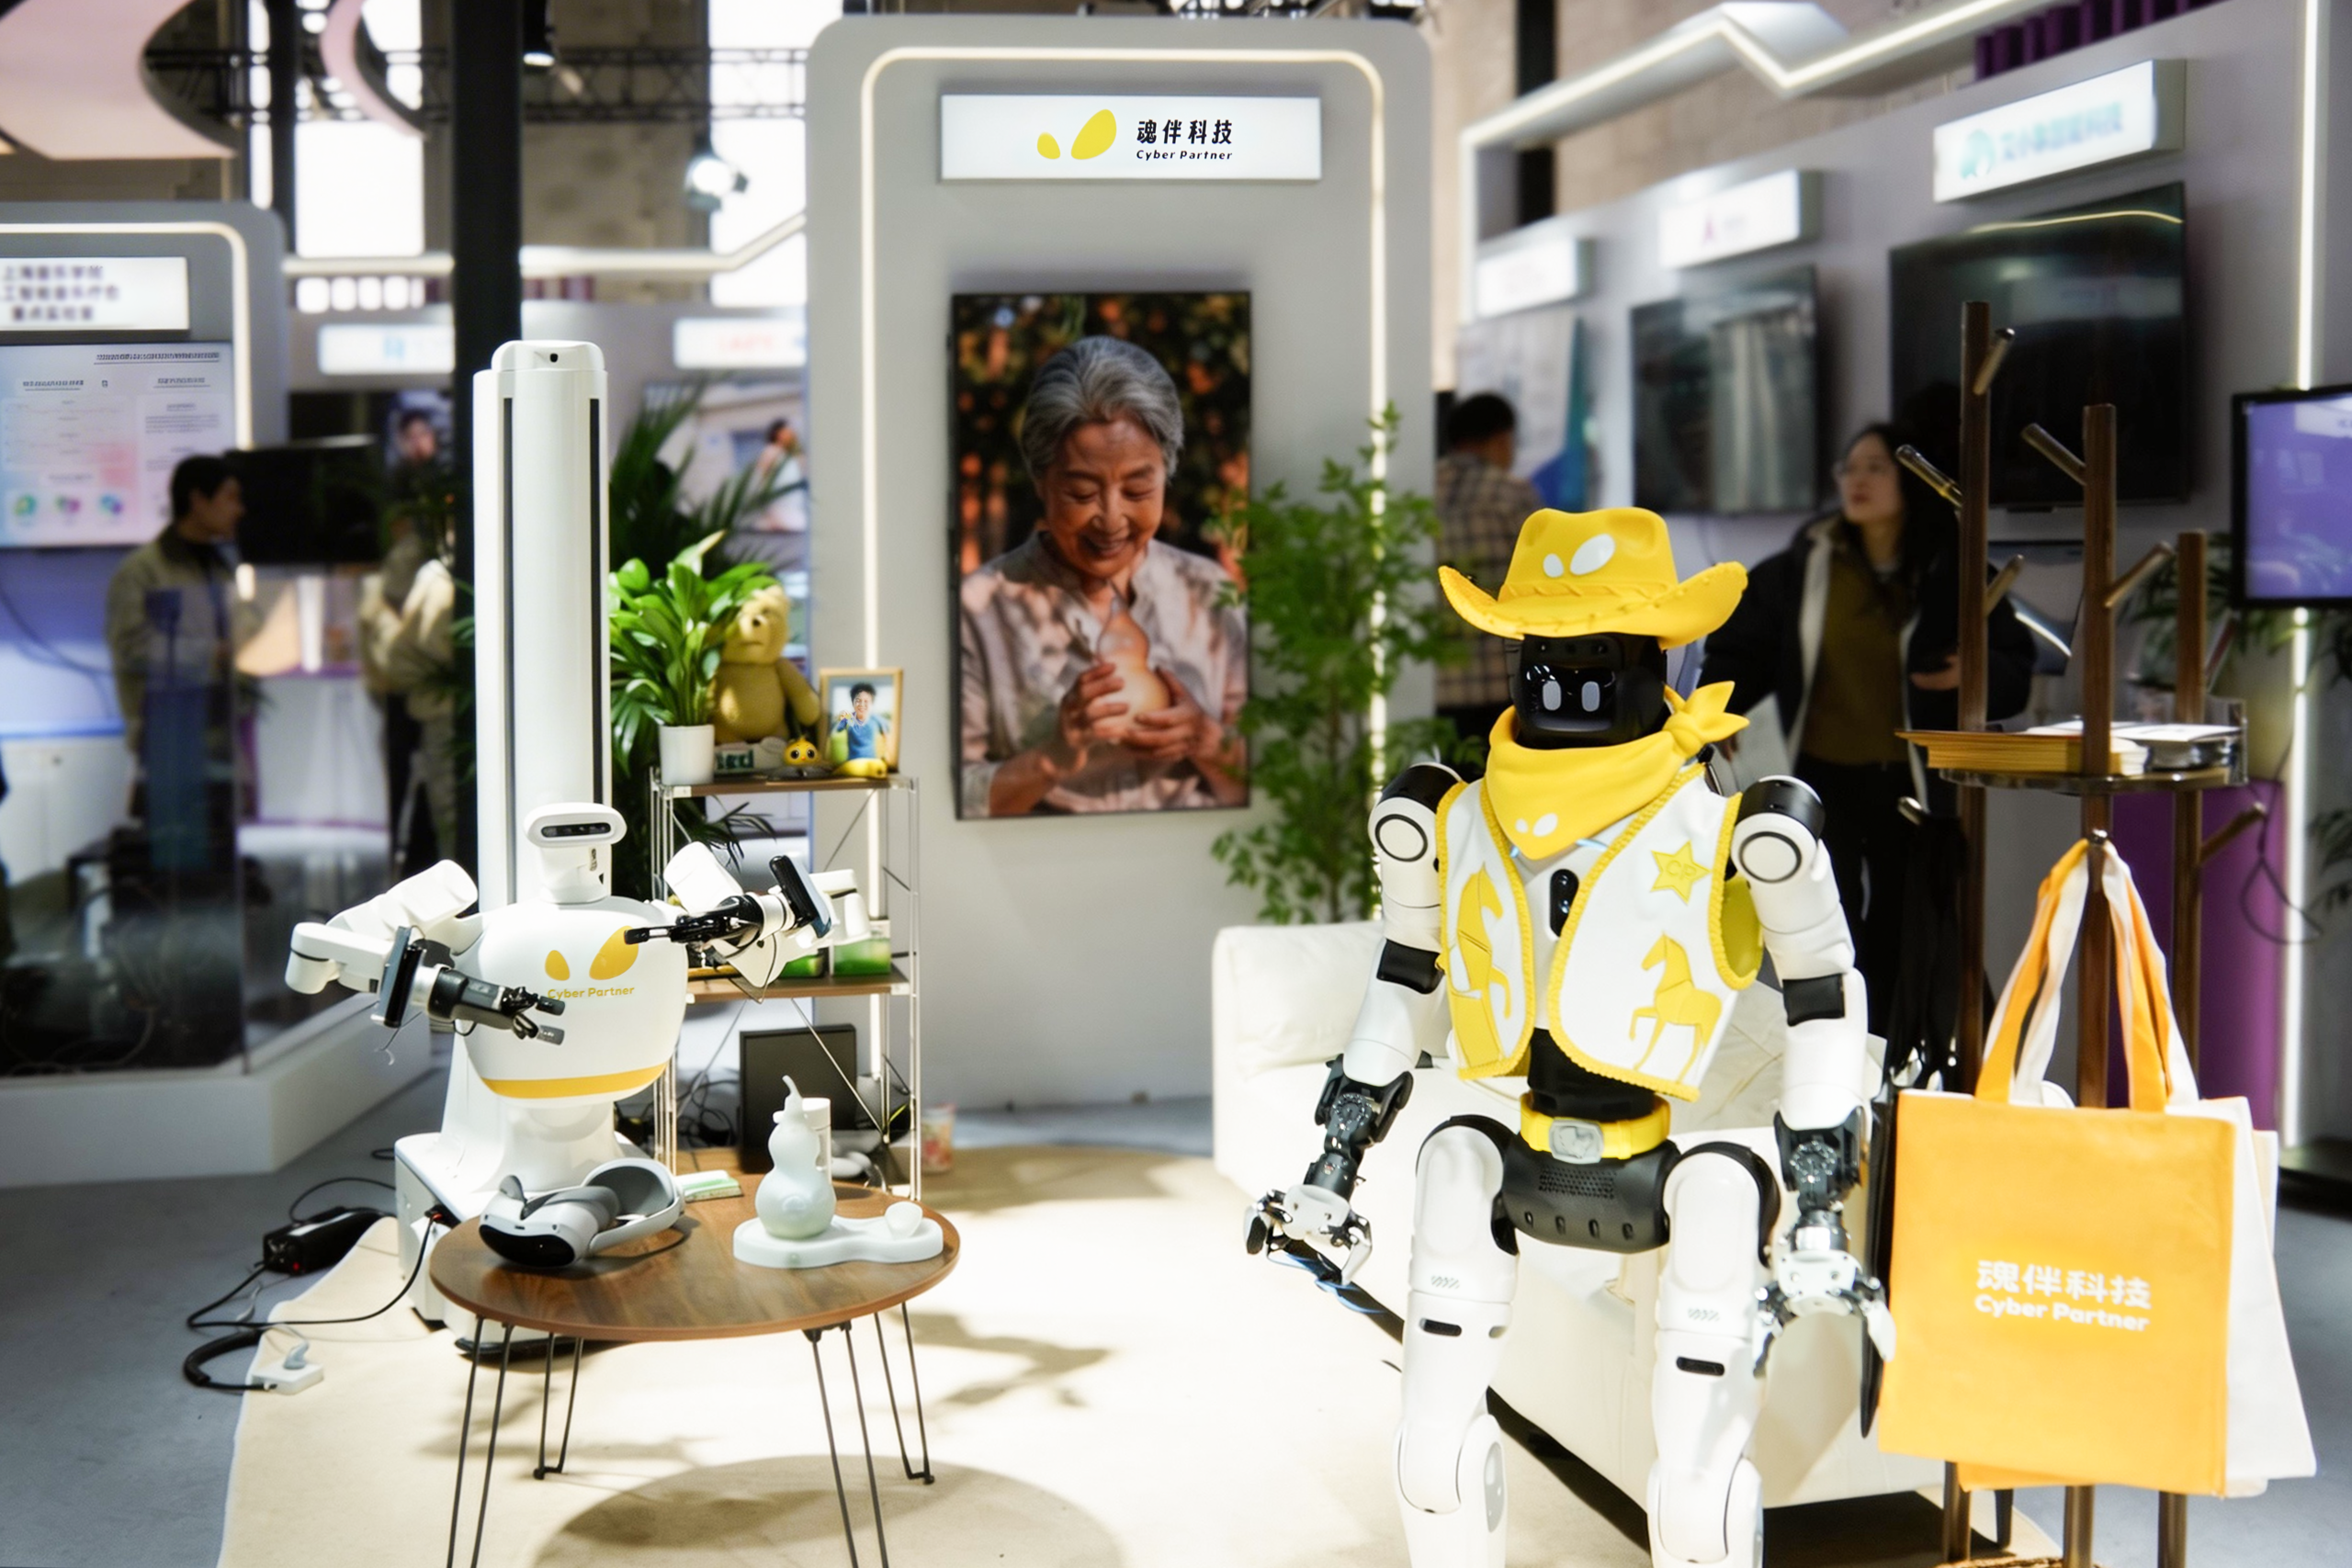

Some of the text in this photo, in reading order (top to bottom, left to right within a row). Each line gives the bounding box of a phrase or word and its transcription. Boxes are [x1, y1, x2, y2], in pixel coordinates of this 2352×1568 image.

[1136, 119, 1233, 144] 魂伴科技
[1136, 150, 1233, 161] Cyber Partner
[1666, 859, 1697, 880] CP
[548, 987, 635, 1000] Cyber Partner
[1975, 1258, 2152, 1309] 魂伴科技
[1974, 1293, 2151, 1332] Cyber Partner
